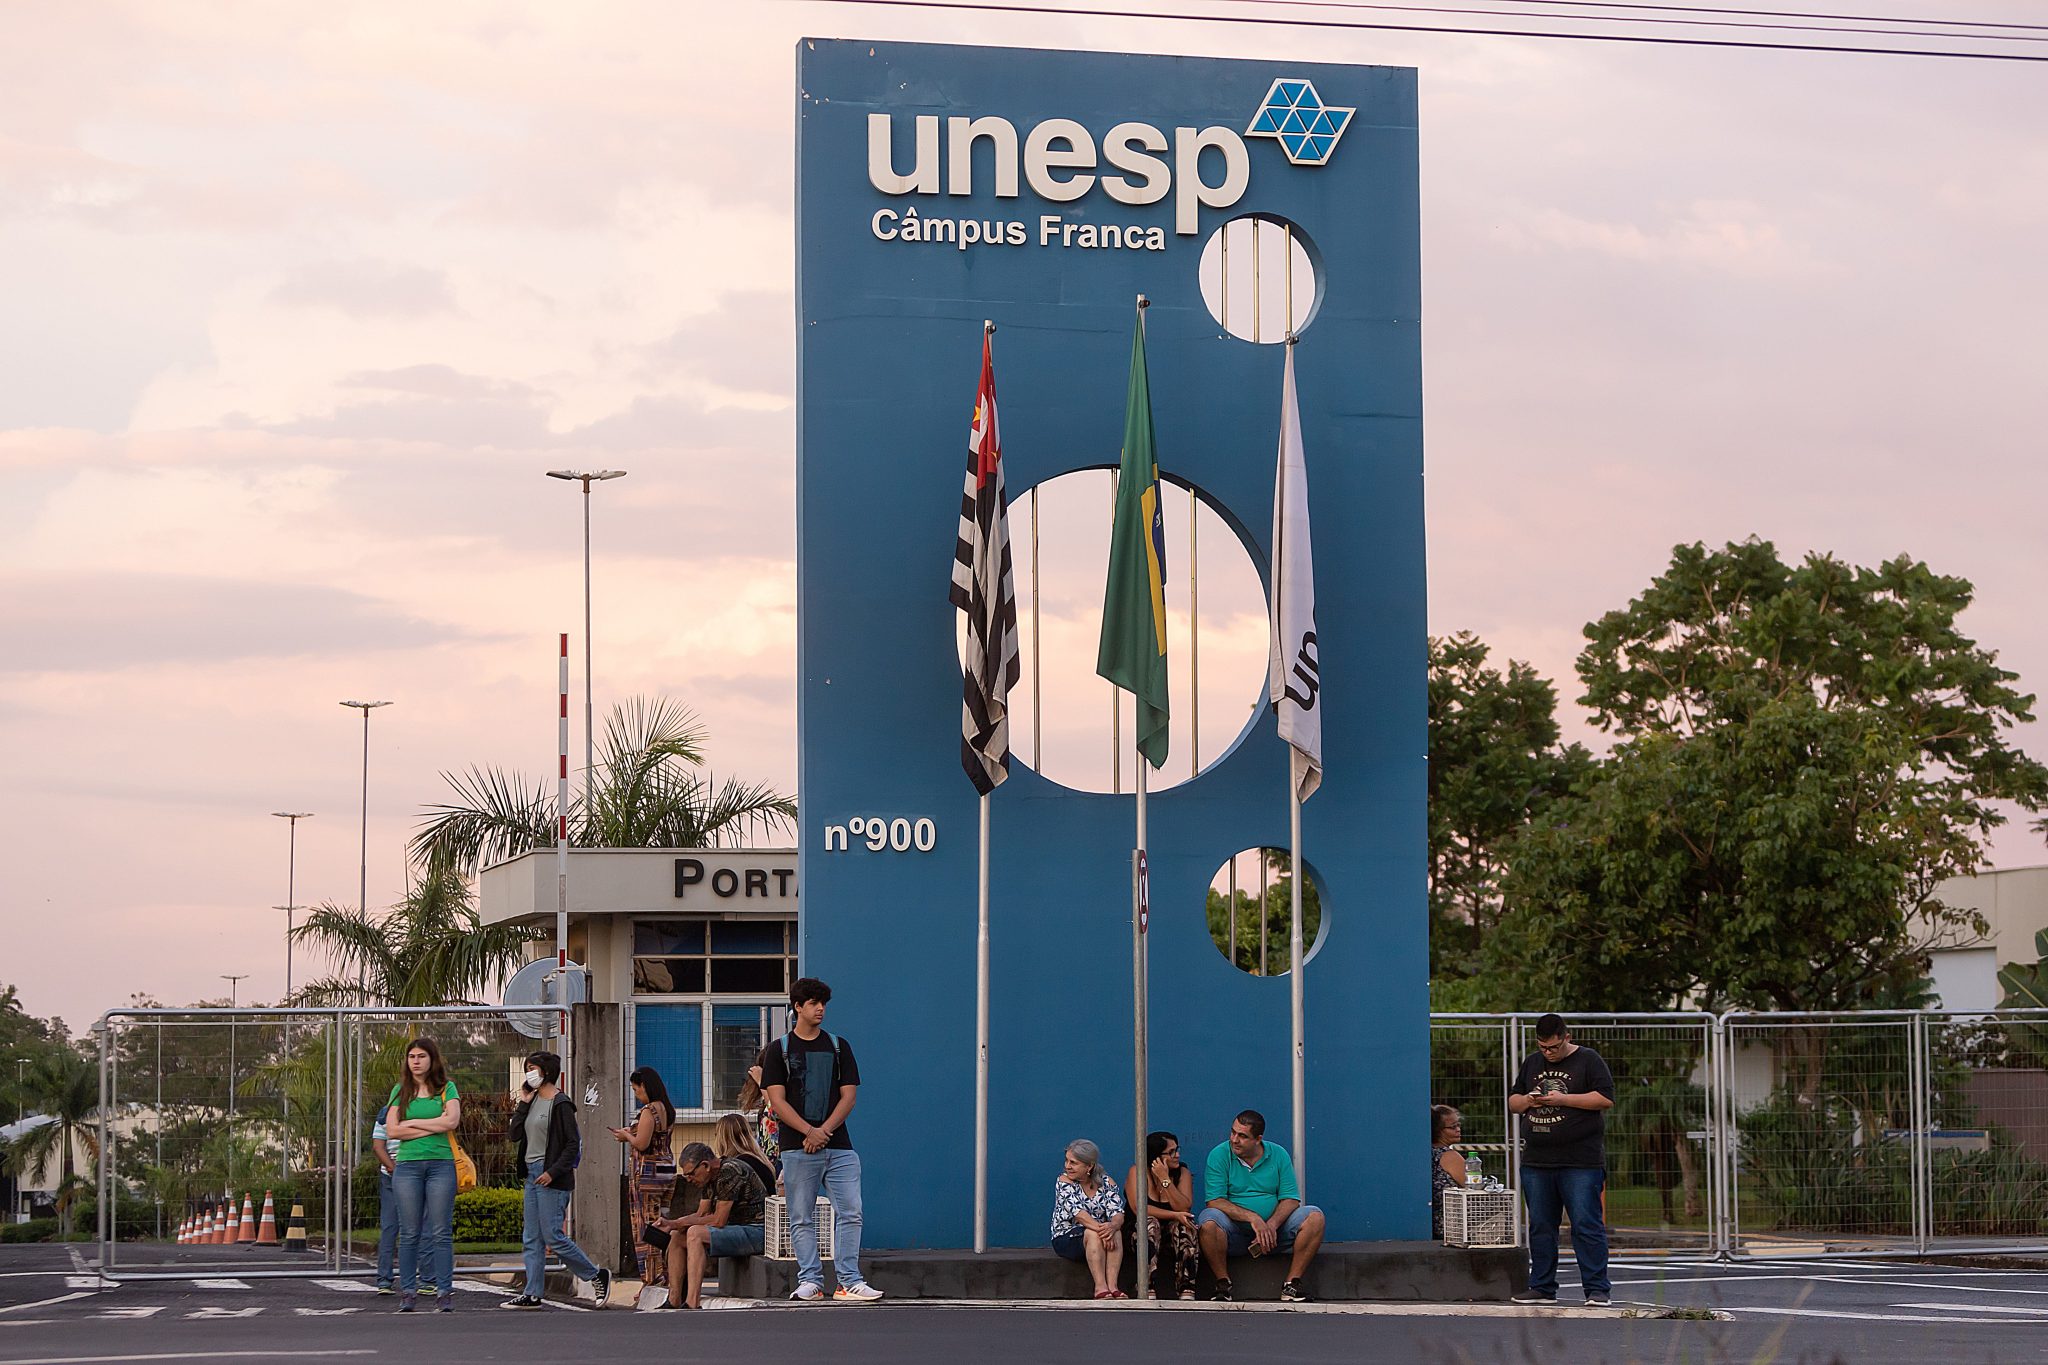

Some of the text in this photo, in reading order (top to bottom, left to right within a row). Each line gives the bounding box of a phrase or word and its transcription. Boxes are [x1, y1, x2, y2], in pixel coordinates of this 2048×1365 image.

[867, 112, 1250, 236] unesp
[870, 206, 1166, 251] Câmpus Franca
[674, 858, 798, 898] PORT
[1538, 1071, 1569, 1079] NATIVE
